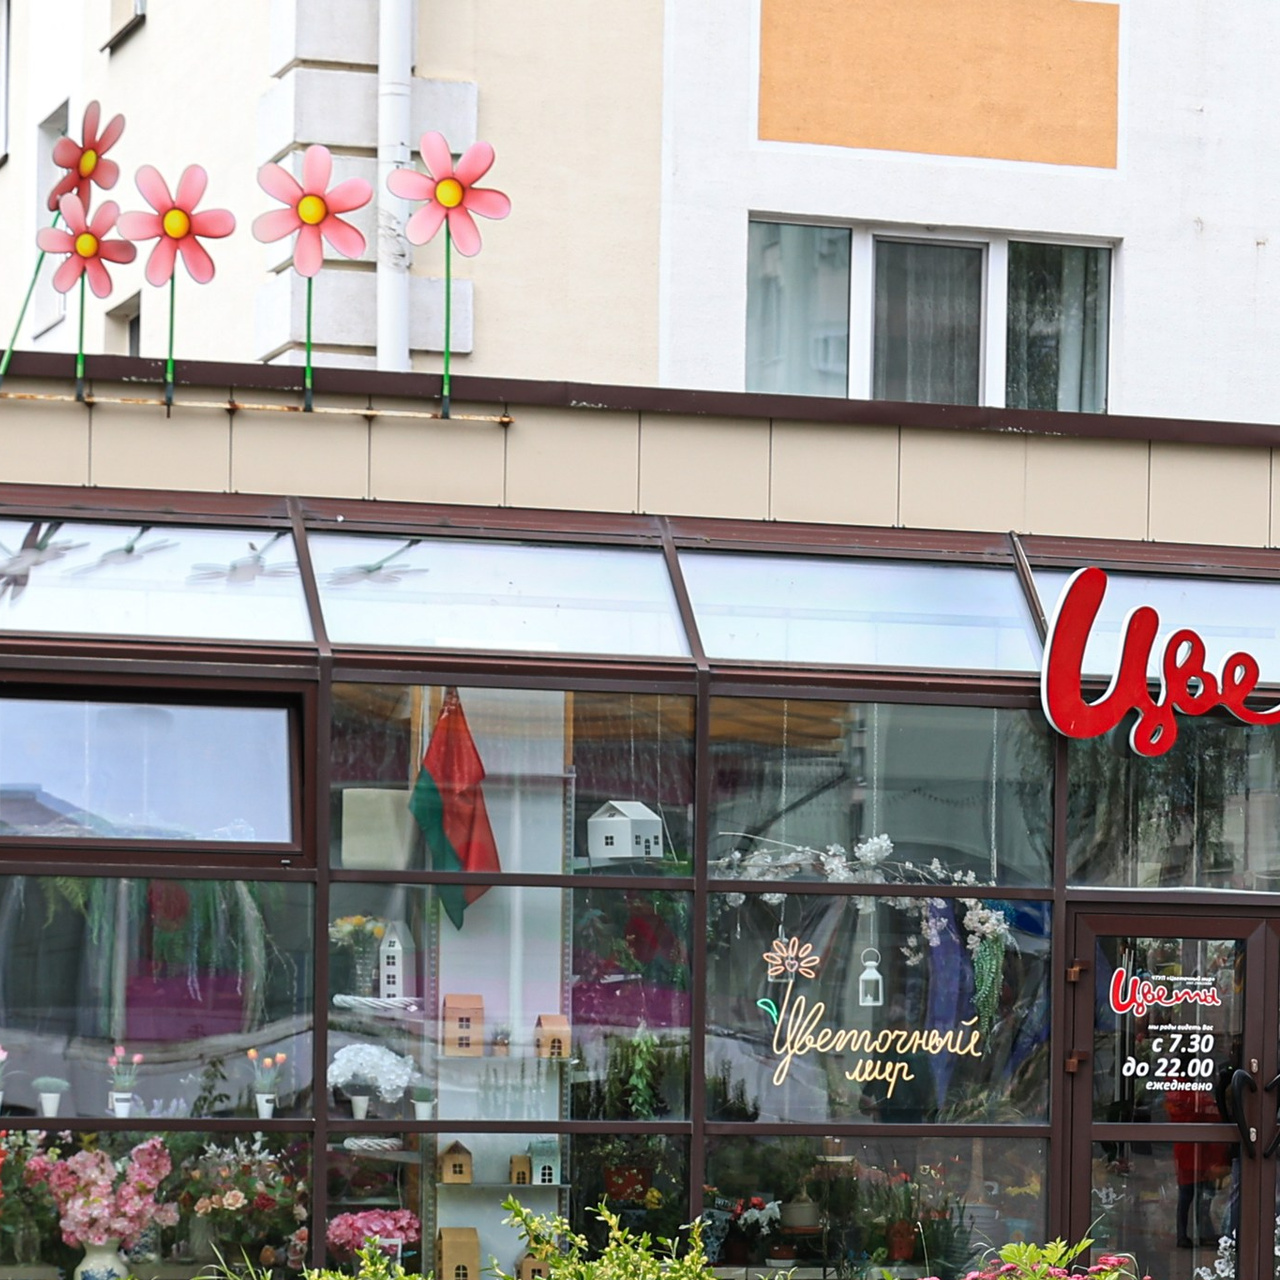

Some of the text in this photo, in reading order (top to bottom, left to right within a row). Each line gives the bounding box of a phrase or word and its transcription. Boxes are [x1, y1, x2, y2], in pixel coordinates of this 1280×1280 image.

[1110, 968, 1221, 1017] Цветы
[772, 980, 983, 1086] Цветочный
[1151, 1033, 1214, 1053] с 7.30
[845, 1058, 915, 1099] мир
[1122, 1056, 1214, 1077] до 22.00
[1145, 1079, 1213, 1091] ежедневно
